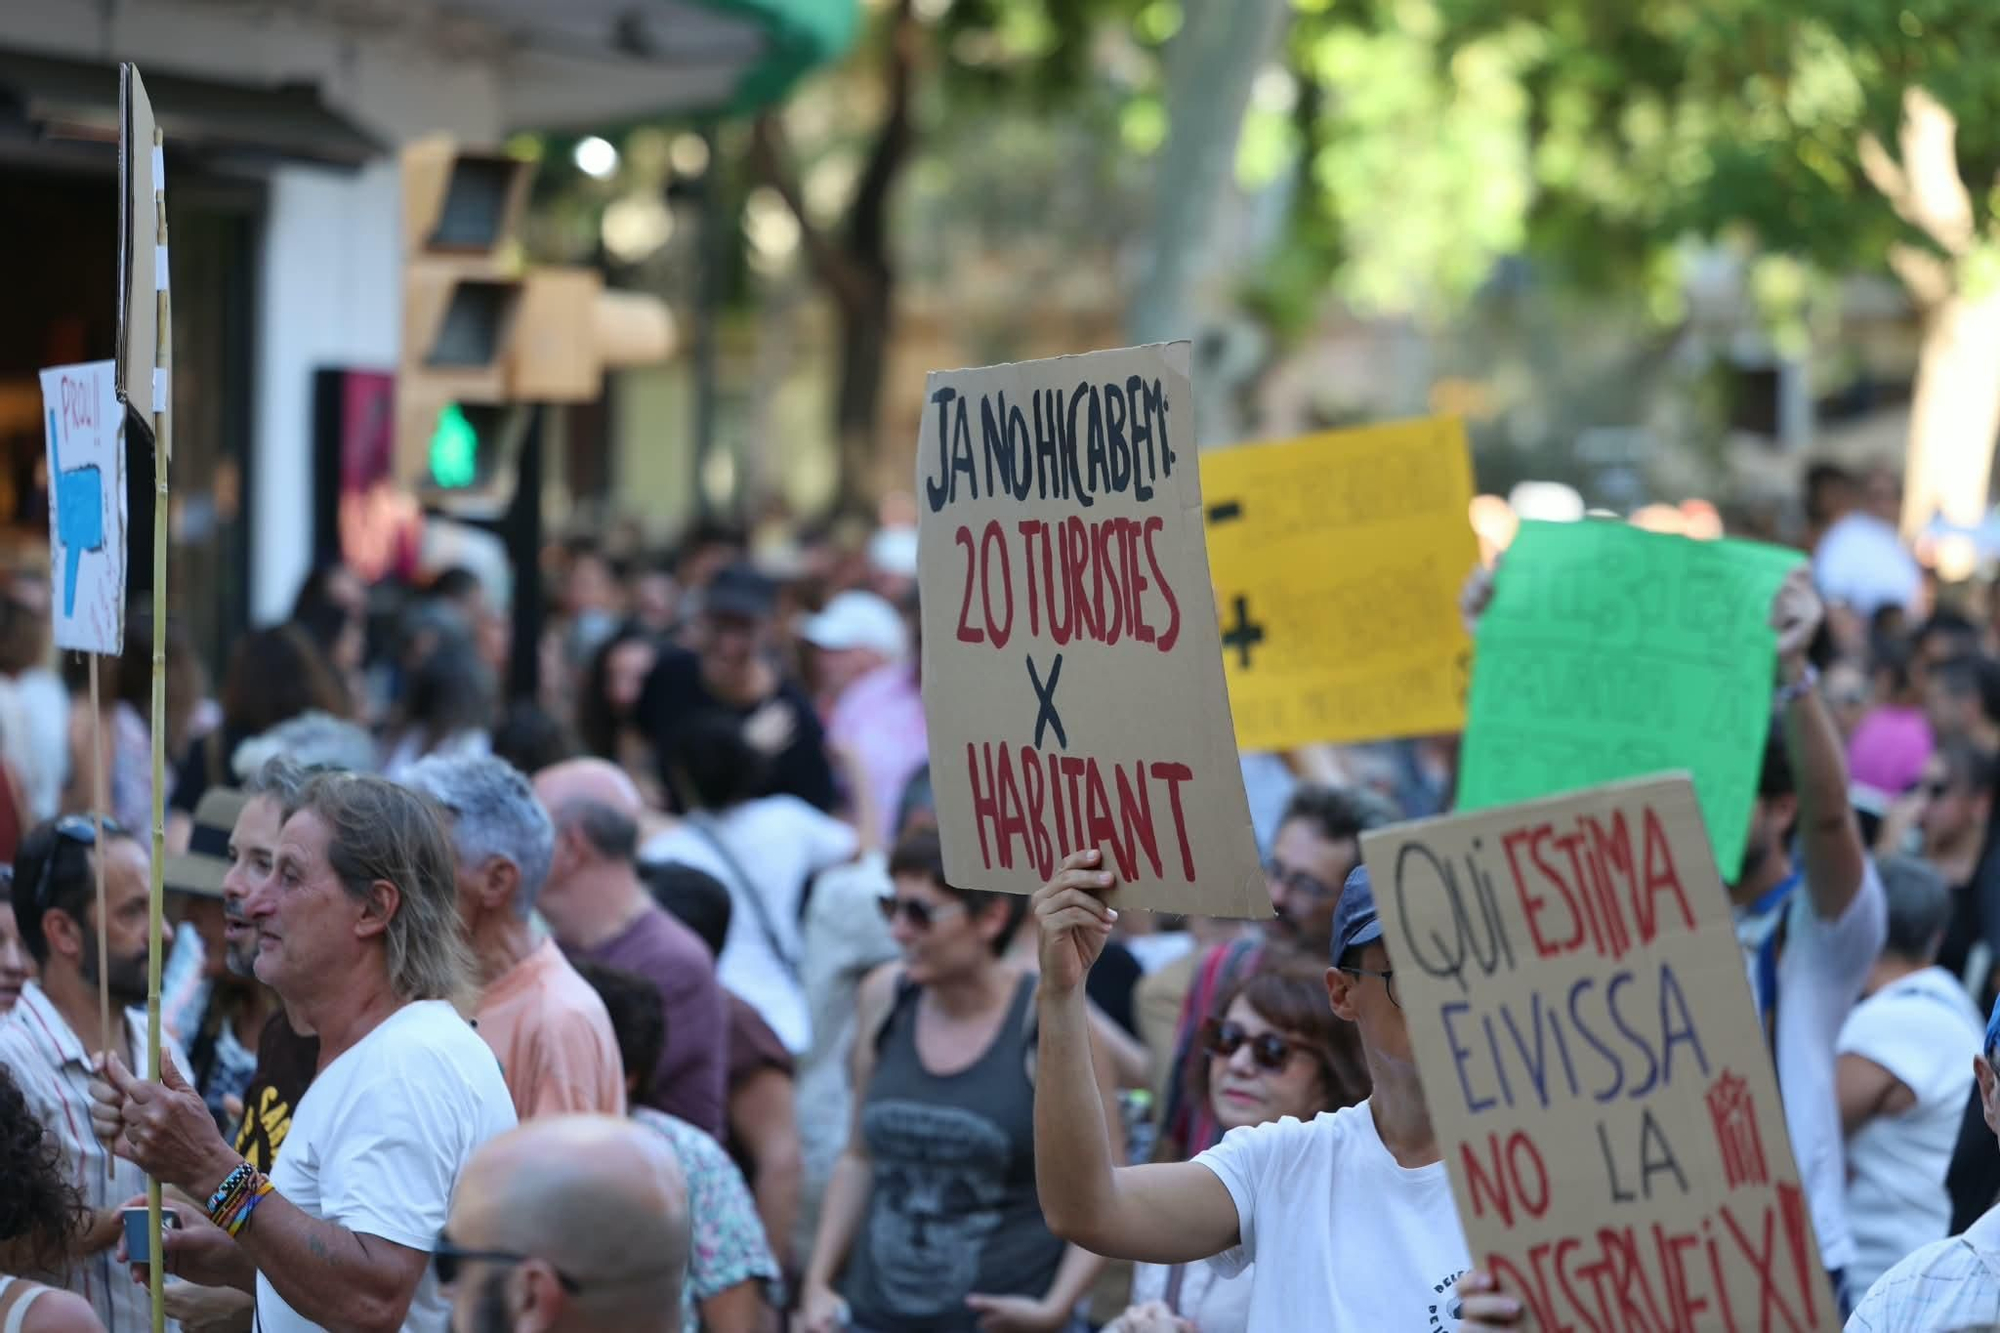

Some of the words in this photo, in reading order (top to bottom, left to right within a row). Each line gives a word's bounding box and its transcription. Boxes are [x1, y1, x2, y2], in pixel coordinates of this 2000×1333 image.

[927, 386, 978, 513] JA
[981, 390, 1032, 501] NO
[956, 519, 1014, 649] 20
[1018, 515, 1181, 652] TURISTES
[1026, 653, 1067, 750] X
[967, 740, 1196, 883] HABITANT
[1439, 961, 1710, 1114] EIVISSA
[1459, 1129, 1551, 1229] NO
[1597, 1107, 1690, 1204] LA
